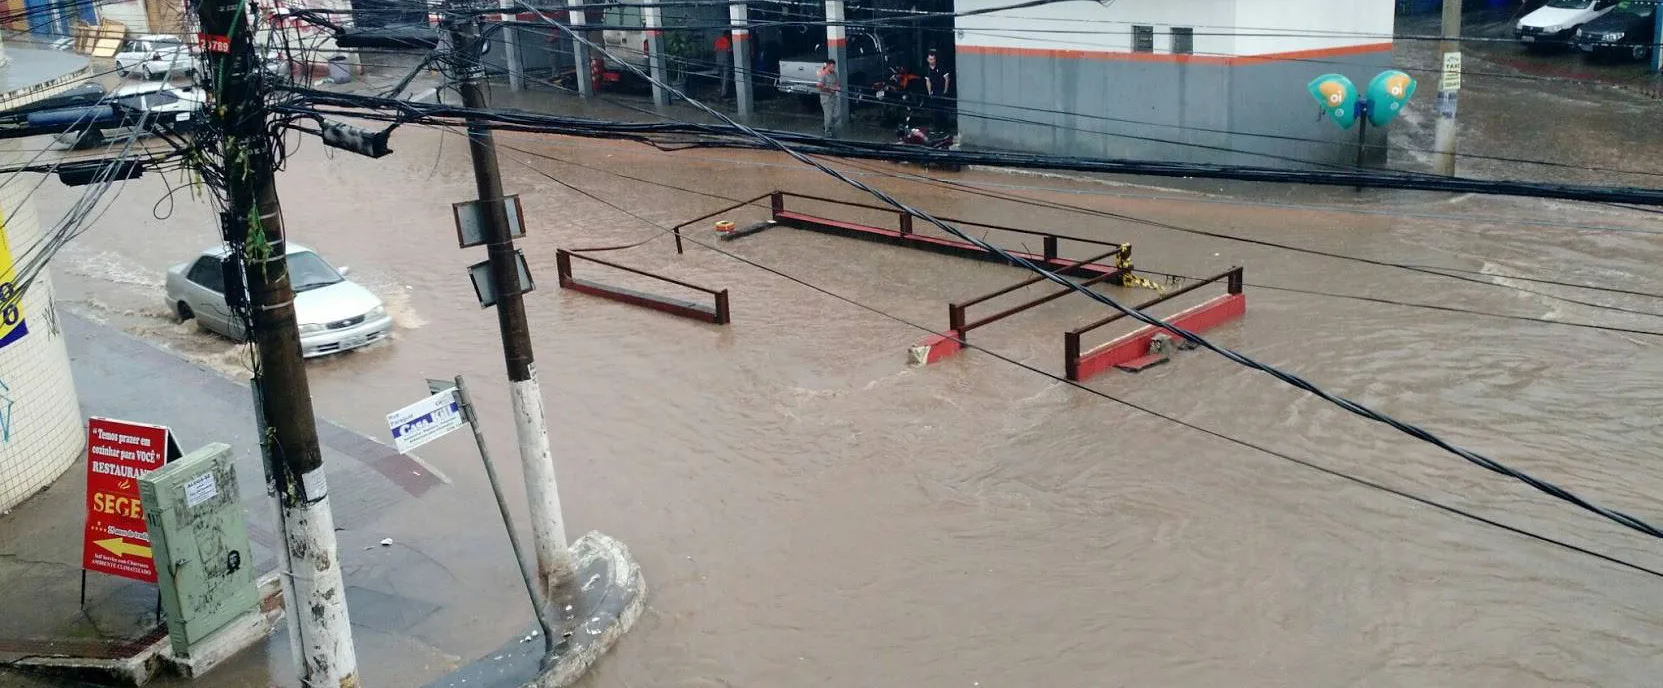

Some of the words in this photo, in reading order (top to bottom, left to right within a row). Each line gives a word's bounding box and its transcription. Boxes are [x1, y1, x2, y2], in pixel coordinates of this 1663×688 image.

[1330, 90, 1342, 103] oi
[119, 434, 140, 444] prazer
[140, 437, 151, 447] em
[92, 445, 119, 457] cozinhar
[120, 450, 136, 460] para
